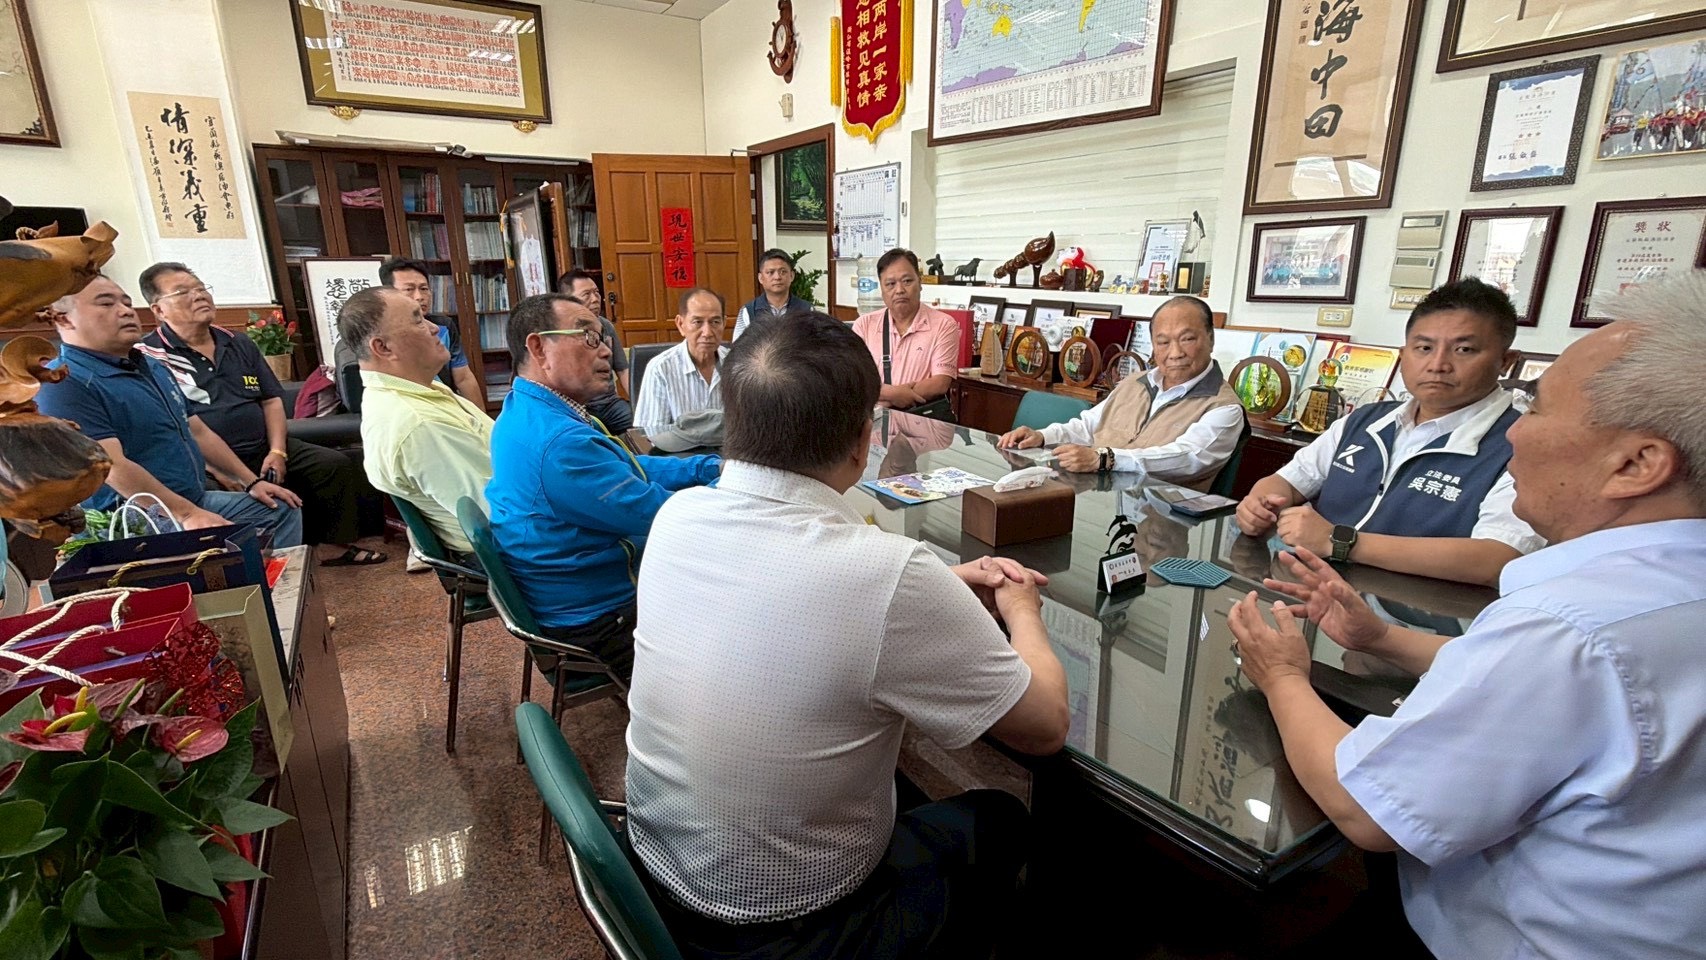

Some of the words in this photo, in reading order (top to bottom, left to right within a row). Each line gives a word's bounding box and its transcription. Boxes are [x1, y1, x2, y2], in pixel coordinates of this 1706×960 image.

[872, 0, 888, 102] 两岸一家亲
[1407, 476, 1463, 502] 吳宗憲
[1424, 469, 1462, 484] 立法委員
